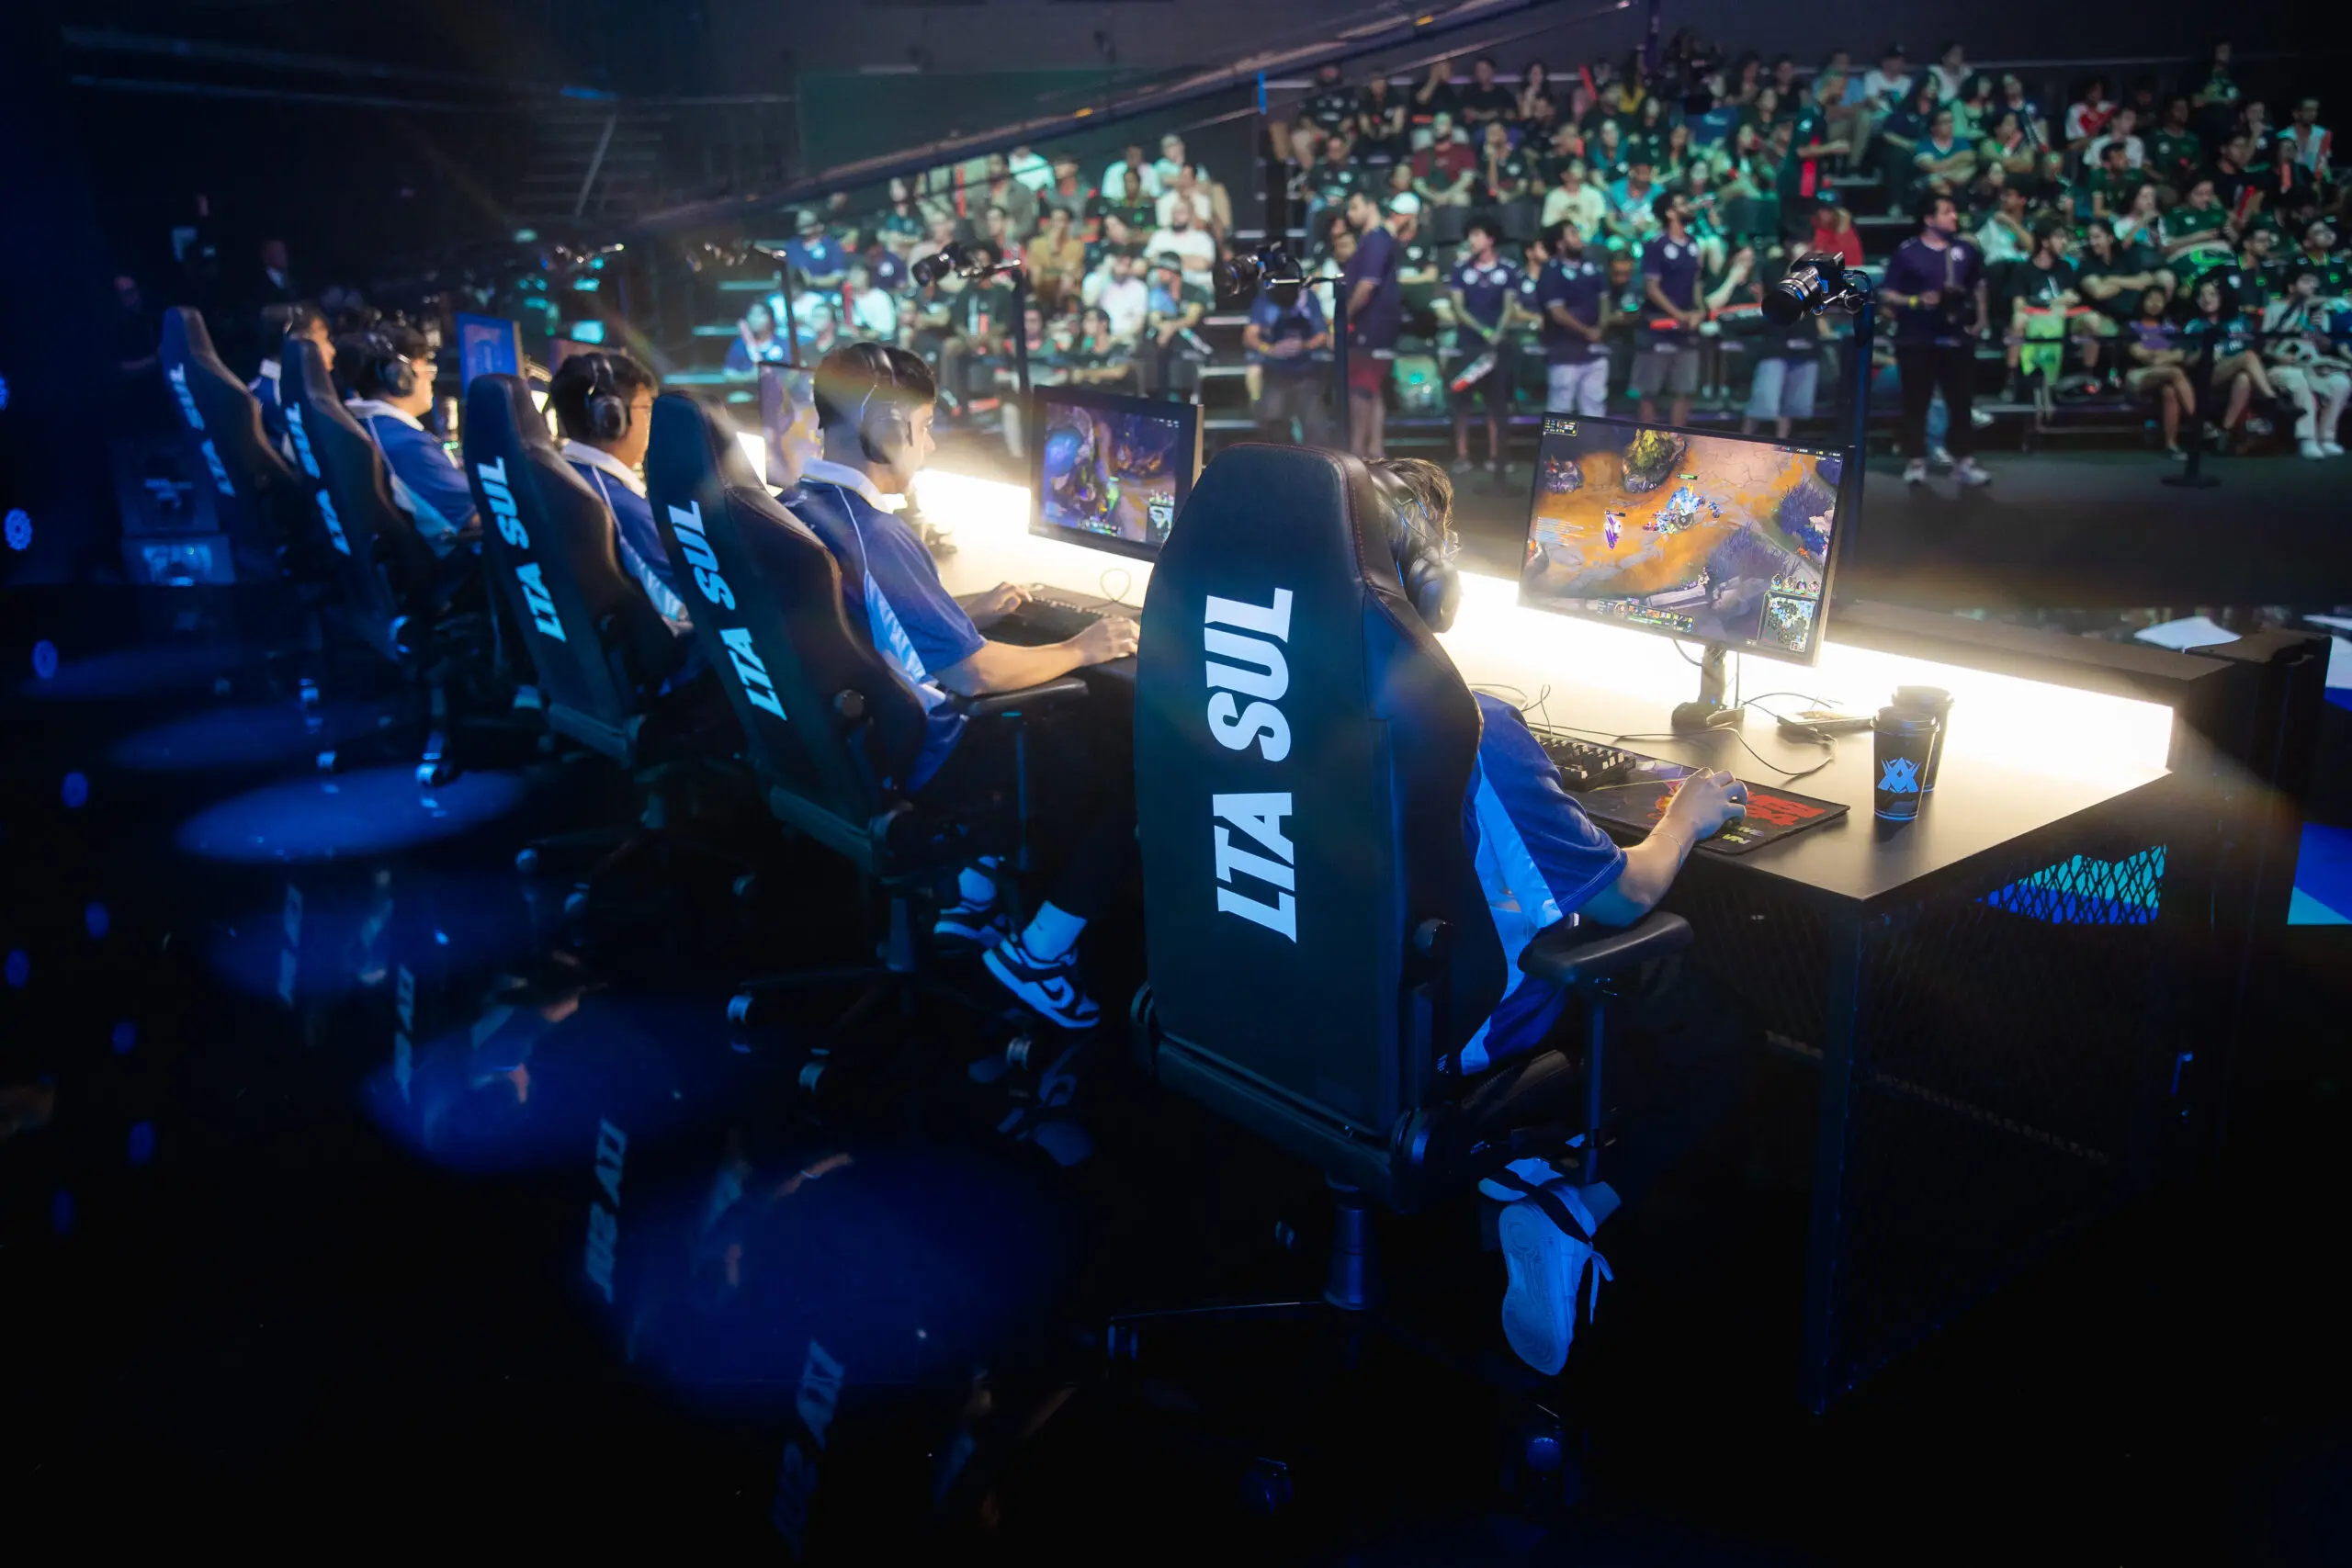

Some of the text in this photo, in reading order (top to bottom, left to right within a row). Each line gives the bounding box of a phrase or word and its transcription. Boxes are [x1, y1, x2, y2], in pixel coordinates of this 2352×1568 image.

[478, 457, 567, 642] LTA SUL
[668, 501, 787, 721] LTA SUL
[1204, 588, 1296, 943] LTA SUL
